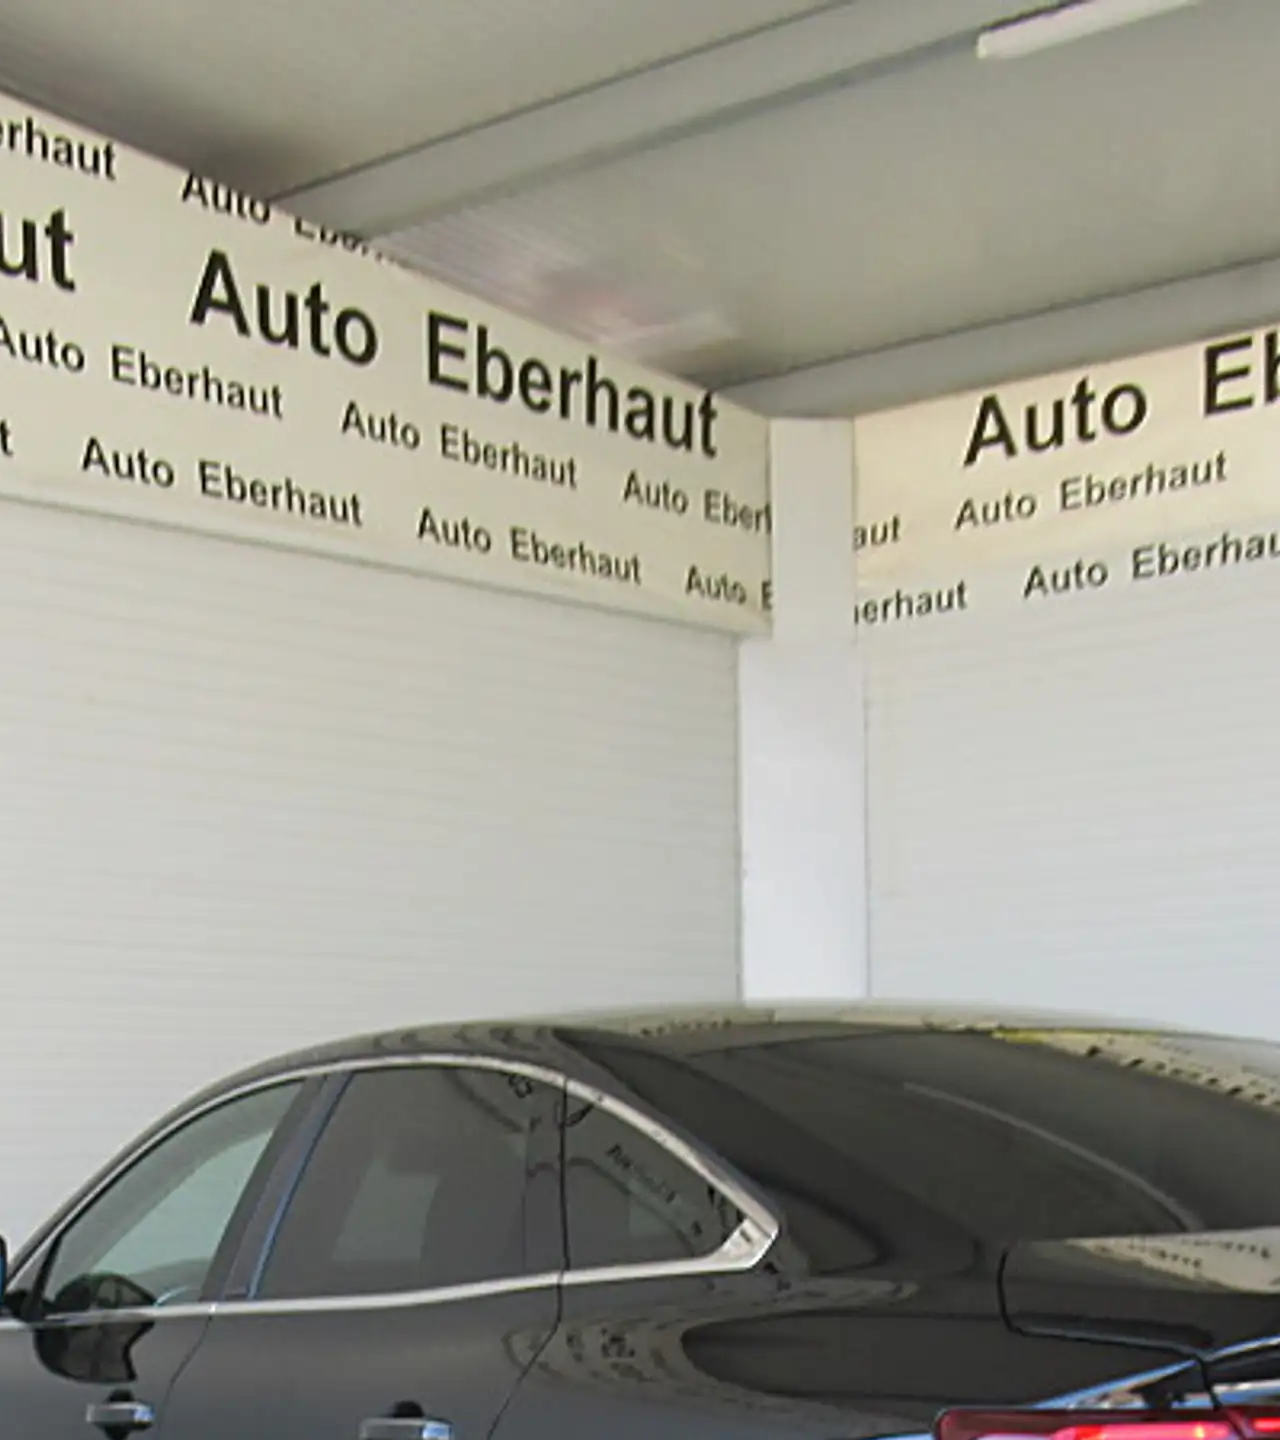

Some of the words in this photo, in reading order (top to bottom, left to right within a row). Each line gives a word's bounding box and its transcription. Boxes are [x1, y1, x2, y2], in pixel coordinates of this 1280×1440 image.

[181, 171, 270, 225] Auto
[112, 345, 281, 418] Eberhaut
[191, 250, 377, 365] Auto
[428, 311, 718, 457] Eberhaut
[342, 401, 420, 449] Auto
[441, 424, 576, 488] Eberhaut
[964, 376, 1146, 466] Auto
[83, 438, 174, 487] Auto
[199, 460, 361, 526] Eberhaut
[624, 471, 688, 514] Auto
[955, 493, 1036, 530] Auto
[1061, 452, 1225, 510] Eberhaut
[418, 508, 491, 553] Auto
[510, 527, 640, 584] Eberhaut
[1024, 561, 1108, 598] Auto
[686, 565, 747, 605] Auto
[854, 580, 967, 625] erhaut
